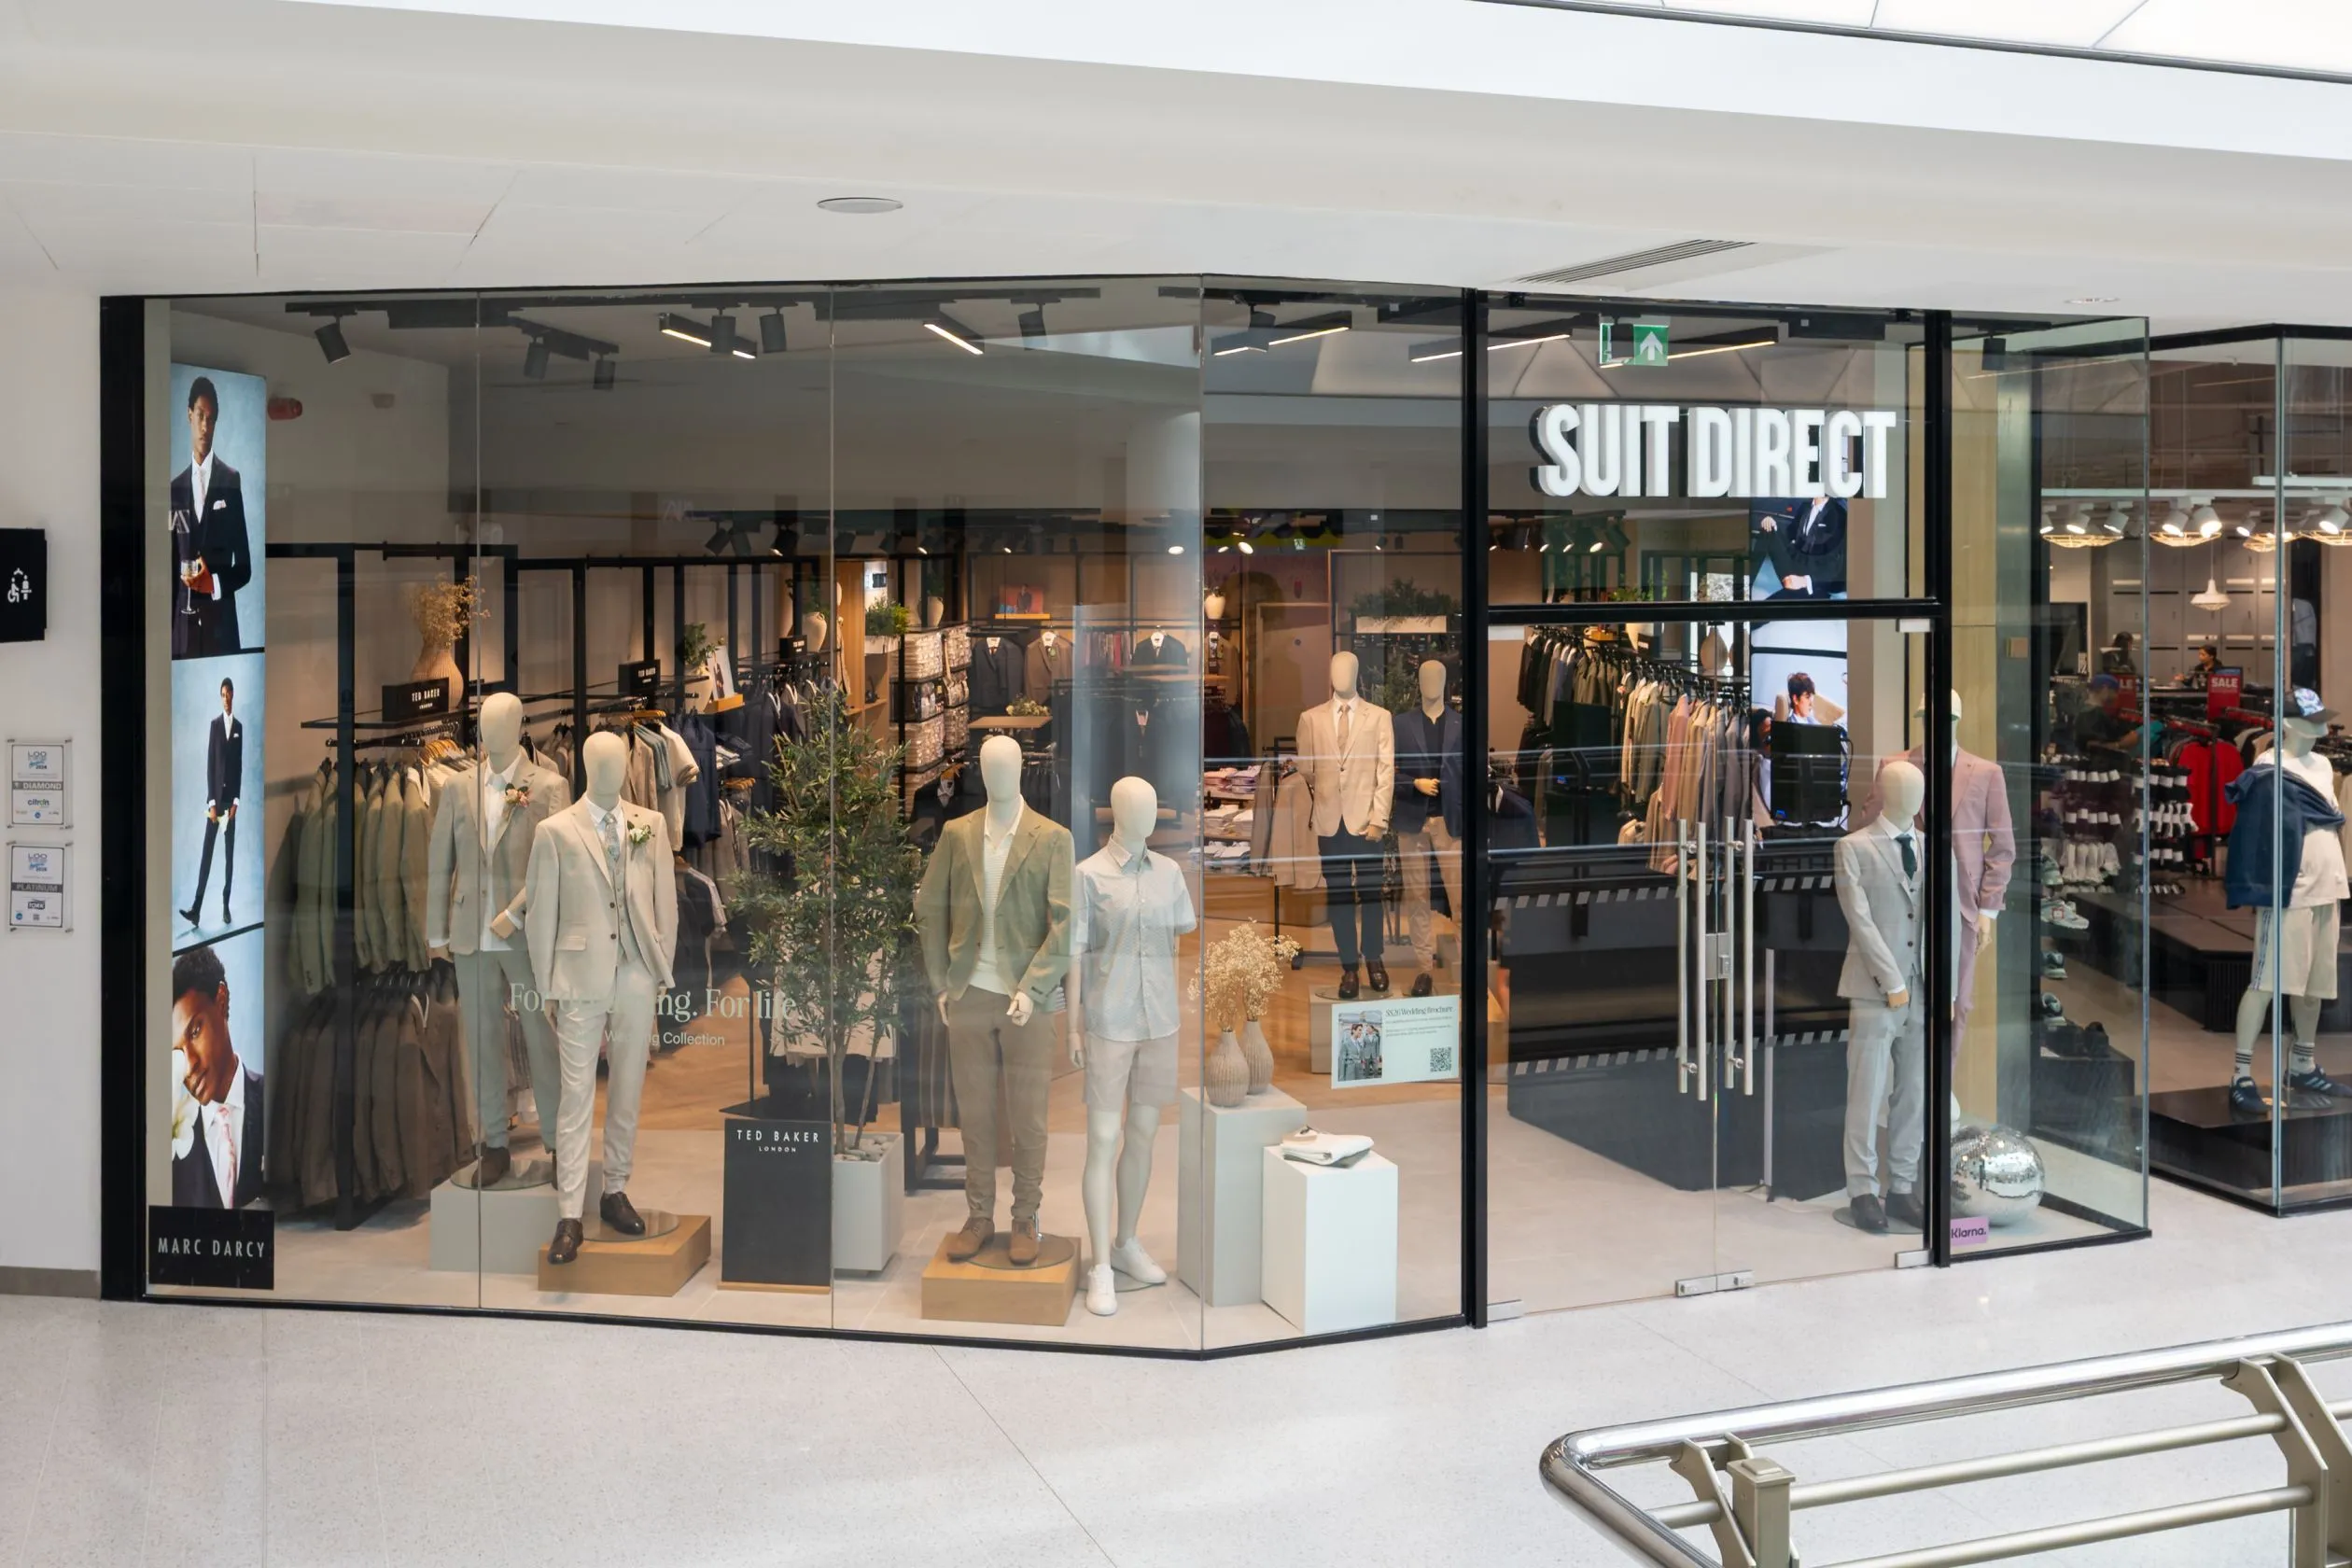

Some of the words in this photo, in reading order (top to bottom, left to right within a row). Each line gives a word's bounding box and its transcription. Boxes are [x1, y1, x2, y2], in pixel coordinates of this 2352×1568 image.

[1535, 403, 1680, 497] SUIT
[1687, 405, 1897, 499] DIRECT
[2211, 677, 2238, 688] SALE
[412, 692, 422, 702] TED
[424, 688, 441, 700] BAKER
[16, 883, 58, 892] PLATINUM
[510, 982, 548, 1013] For
[706, 988, 750, 1018] For
[1401, 1006, 1427, 1016] Wedding
[663, 1030, 725, 1046] Collection
[736, 1129, 763, 1141] TED
[774, 1130, 819, 1143] BAKER
[1951, 1227, 1987, 1239] Klarna.
[158, 1237, 202, 1255] MARC
[212, 1239, 265, 1258] DARCY
